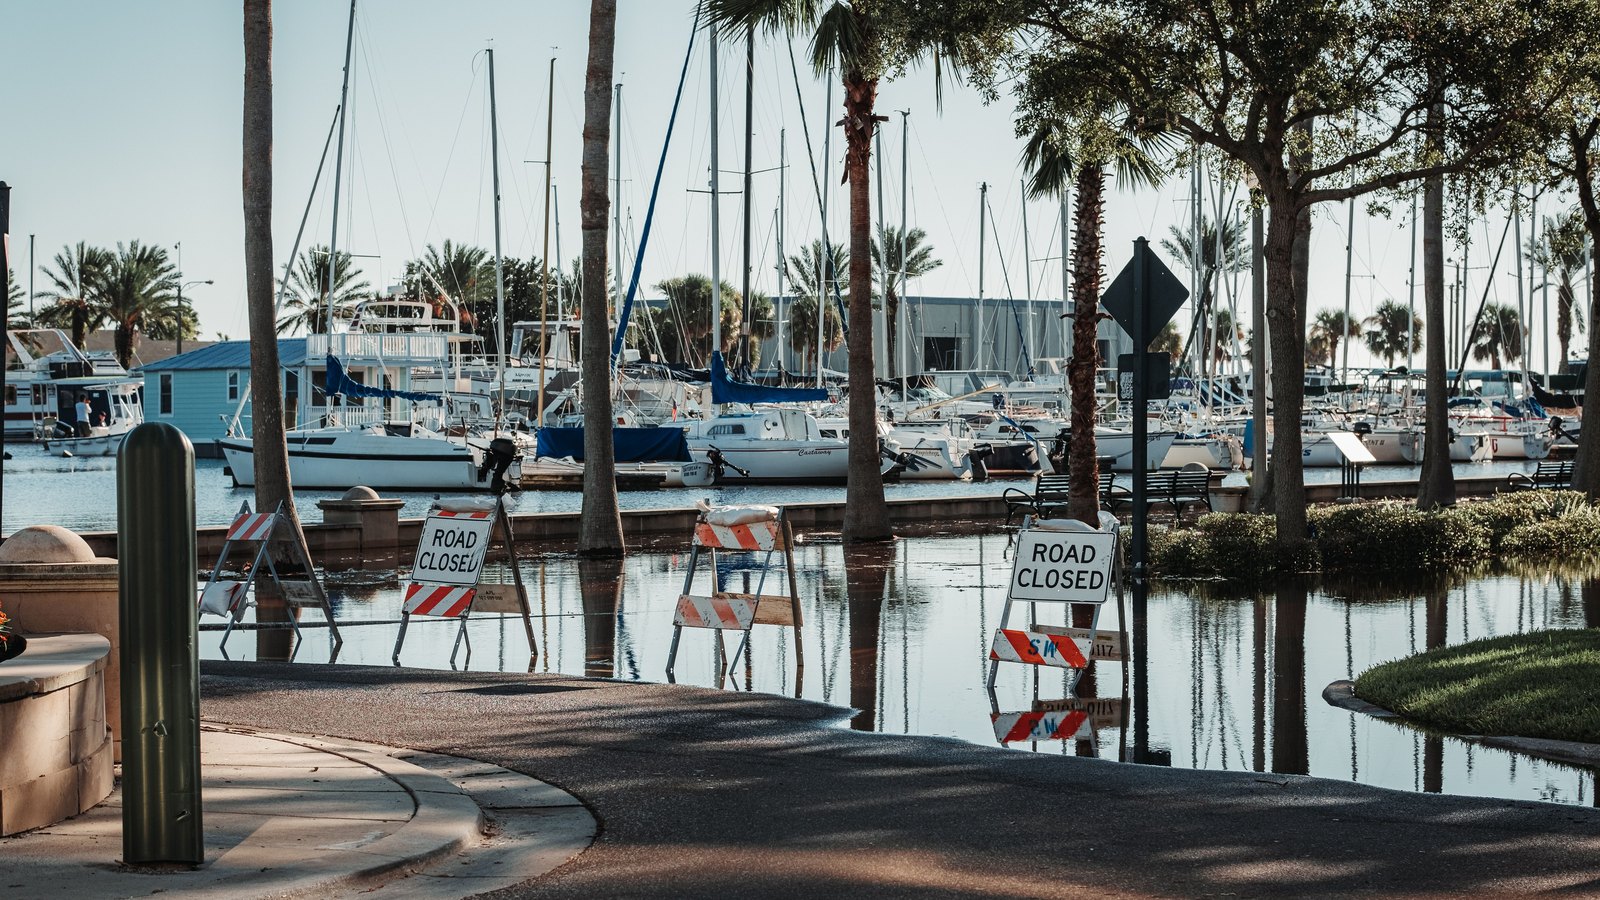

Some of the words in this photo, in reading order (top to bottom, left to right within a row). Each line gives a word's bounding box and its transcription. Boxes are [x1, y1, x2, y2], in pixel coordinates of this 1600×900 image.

[798, 449, 832, 457] Castaway
[432, 528, 477, 549] ROAD
[419, 551, 479, 573] CLOSED
[1031, 543, 1096, 564] ROAD
[1017, 567, 1104, 590] CLOSED
